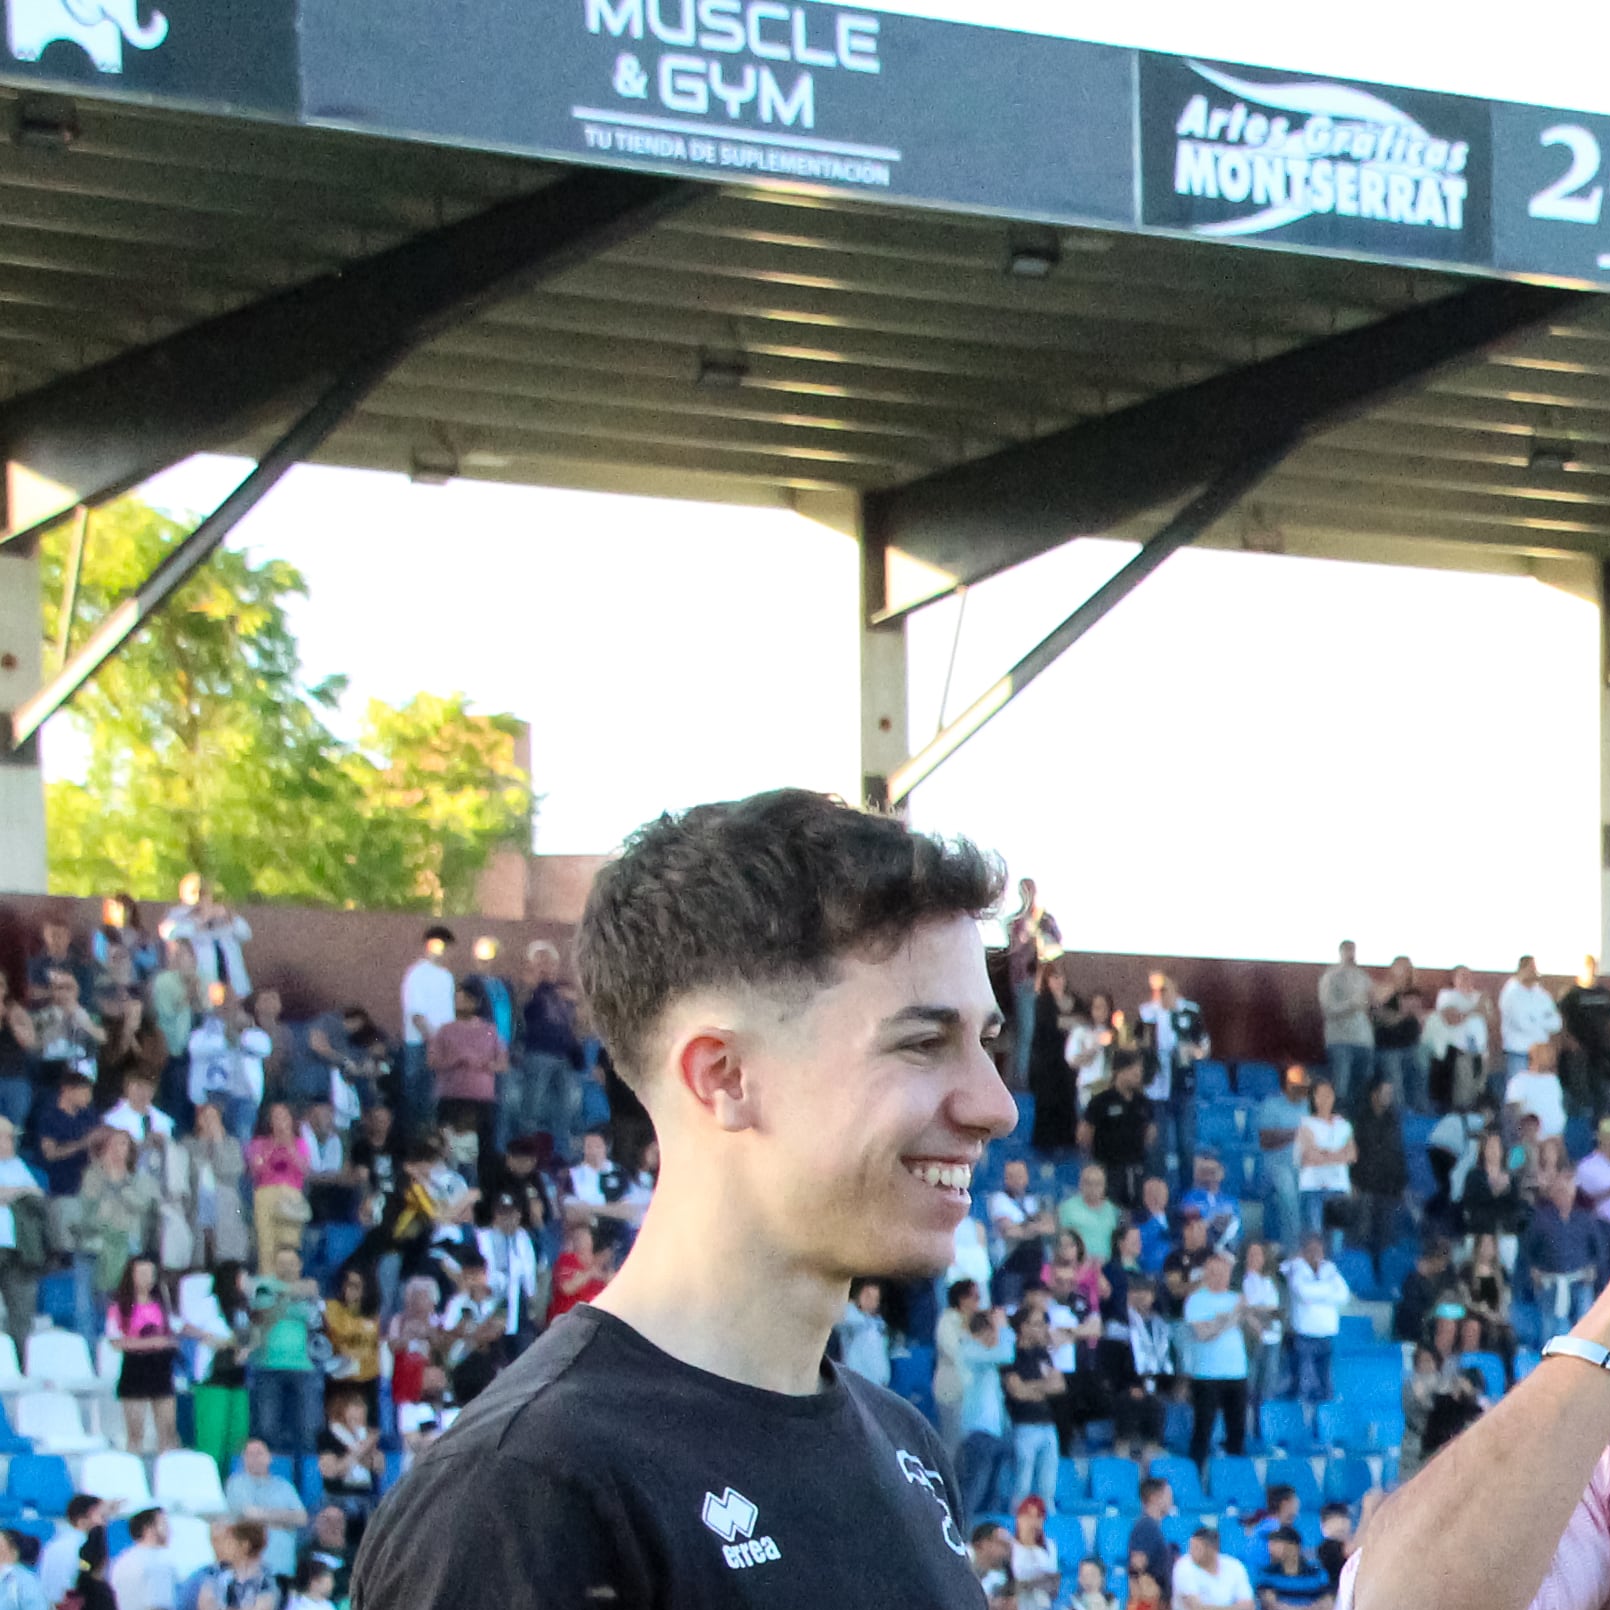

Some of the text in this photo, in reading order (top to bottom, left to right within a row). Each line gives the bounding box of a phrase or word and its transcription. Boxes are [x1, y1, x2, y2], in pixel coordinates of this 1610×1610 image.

[583, 0, 881, 74] MUSCLE
[612, 52, 815, 129] & GYM
[1176, 94, 1290, 147] Artes
[584, 124, 612, 150] TU
[614, 127, 687, 161] TIENDA
[688, 138, 717, 165] DE
[1174, 139, 1468, 231] MONTSERRAT
